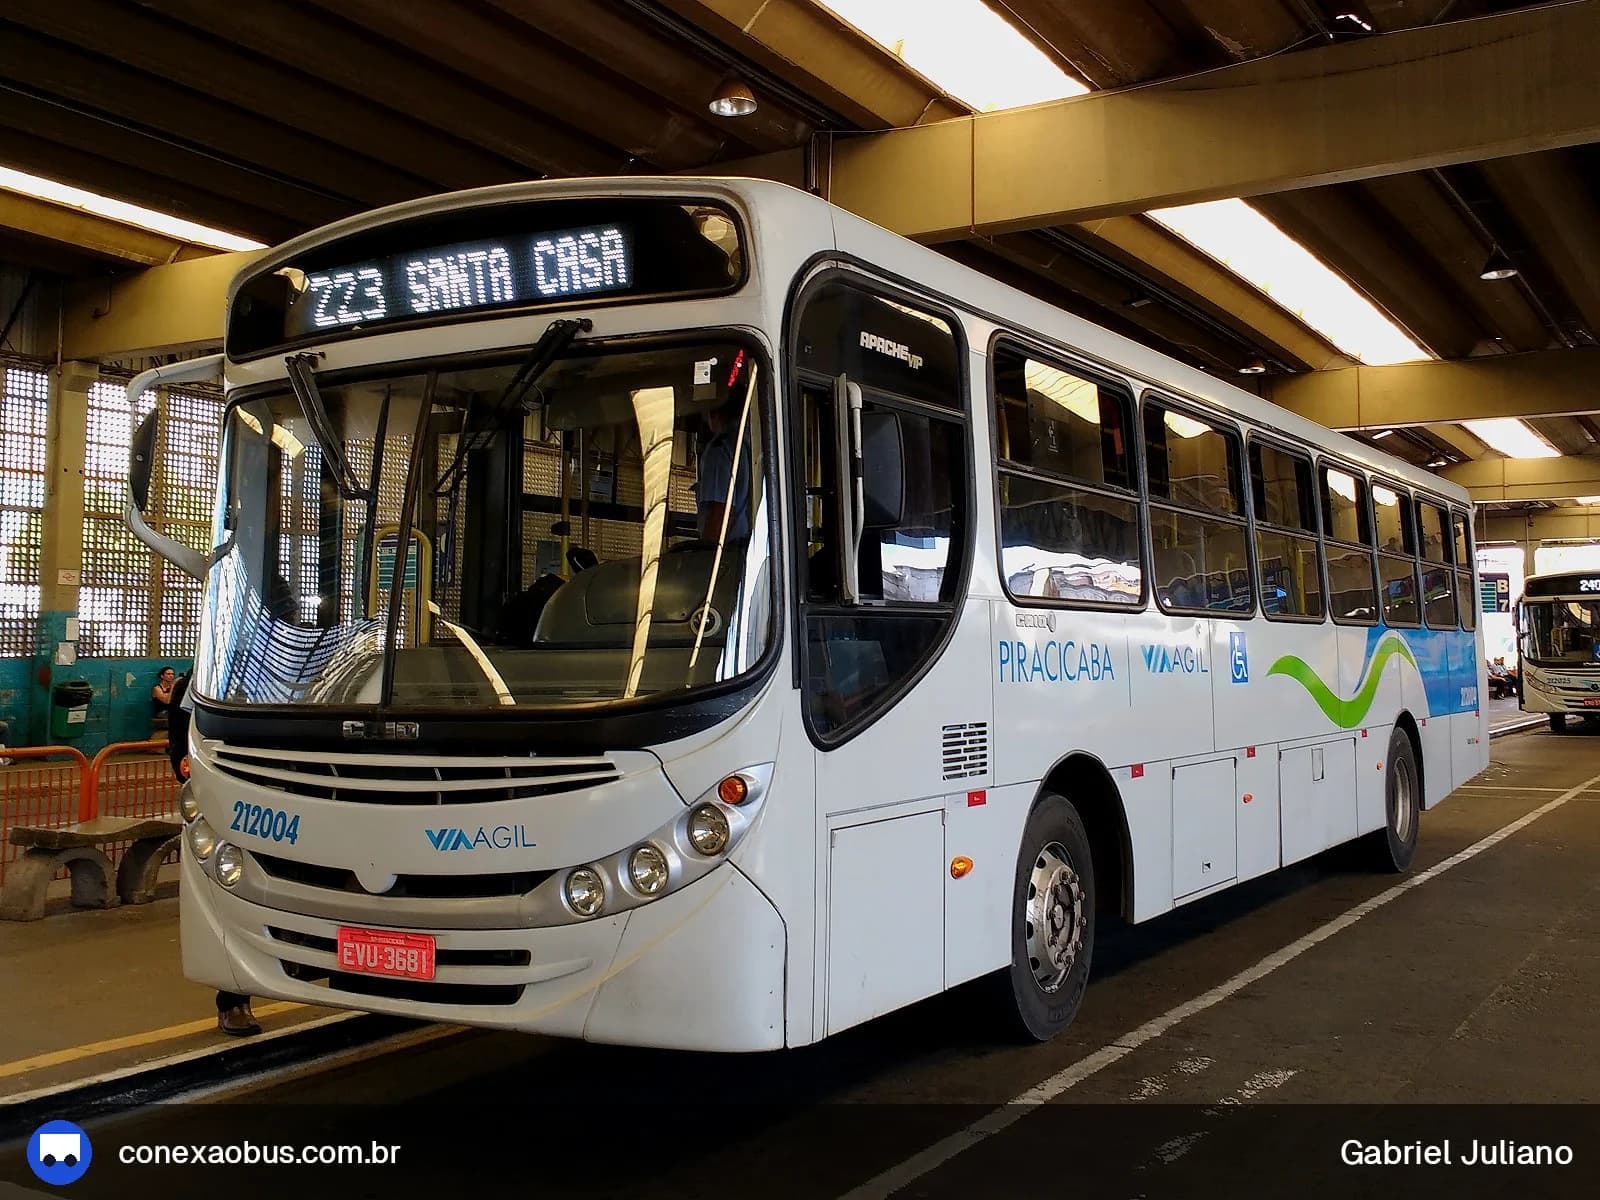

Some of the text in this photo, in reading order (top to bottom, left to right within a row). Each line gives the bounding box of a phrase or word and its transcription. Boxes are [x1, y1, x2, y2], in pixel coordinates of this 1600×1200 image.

[309, 229, 627, 328] 223 SANTA CASA
[999, 640, 1115, 683] PIRACICABA
[230, 800, 301, 845] 212004
